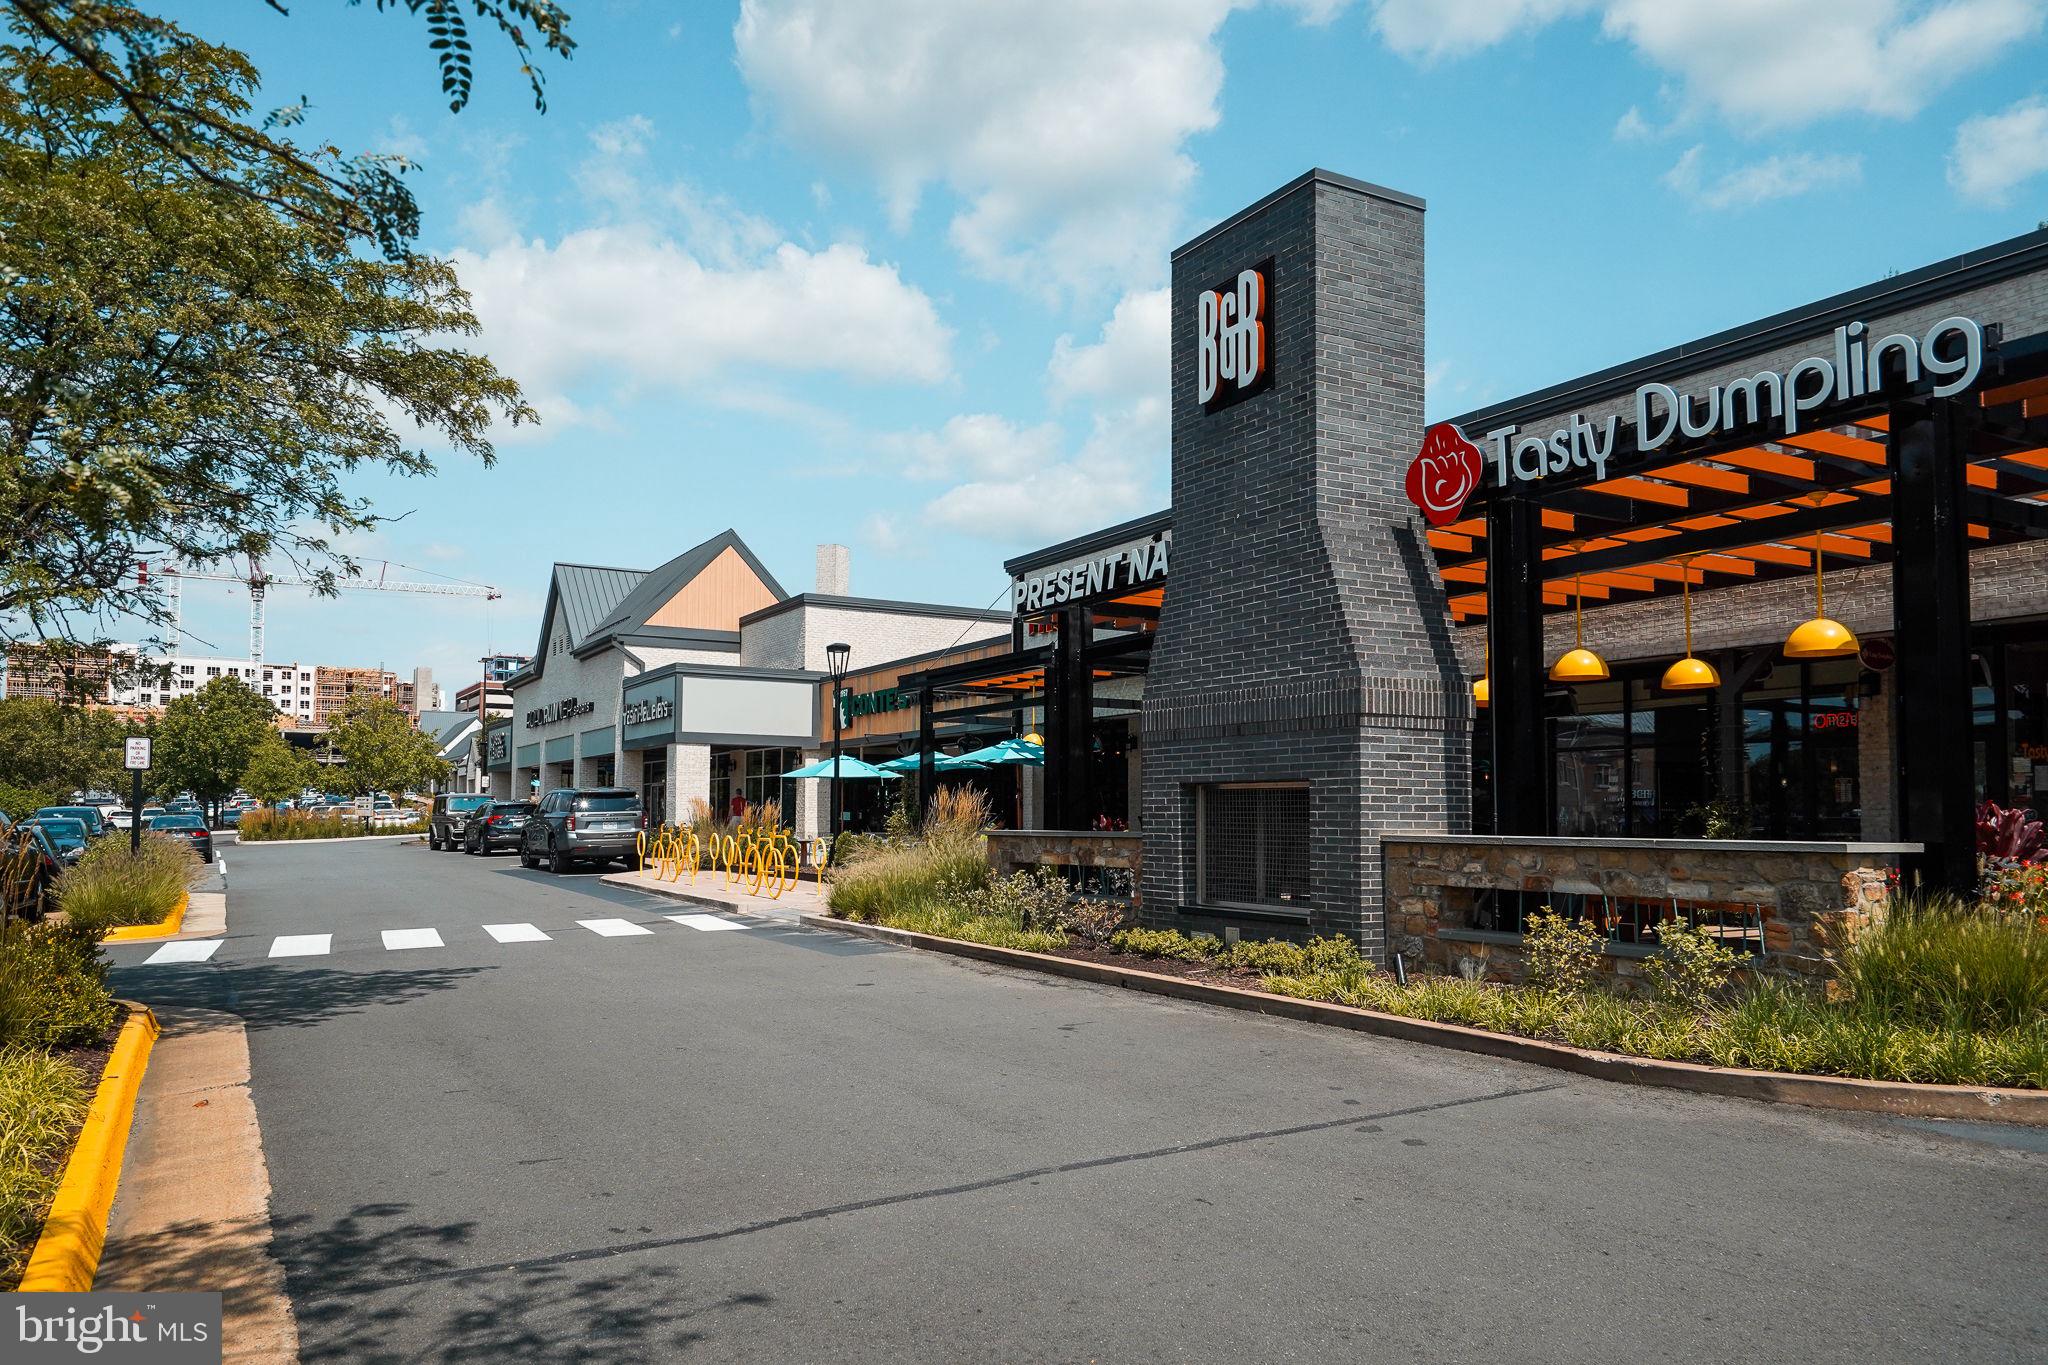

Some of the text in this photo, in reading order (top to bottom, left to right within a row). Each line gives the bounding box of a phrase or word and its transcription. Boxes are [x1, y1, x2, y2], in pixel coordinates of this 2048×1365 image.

[1487, 316, 1986, 487] Tasty Dumpling
[1012, 552, 1124, 618] PRESENT
